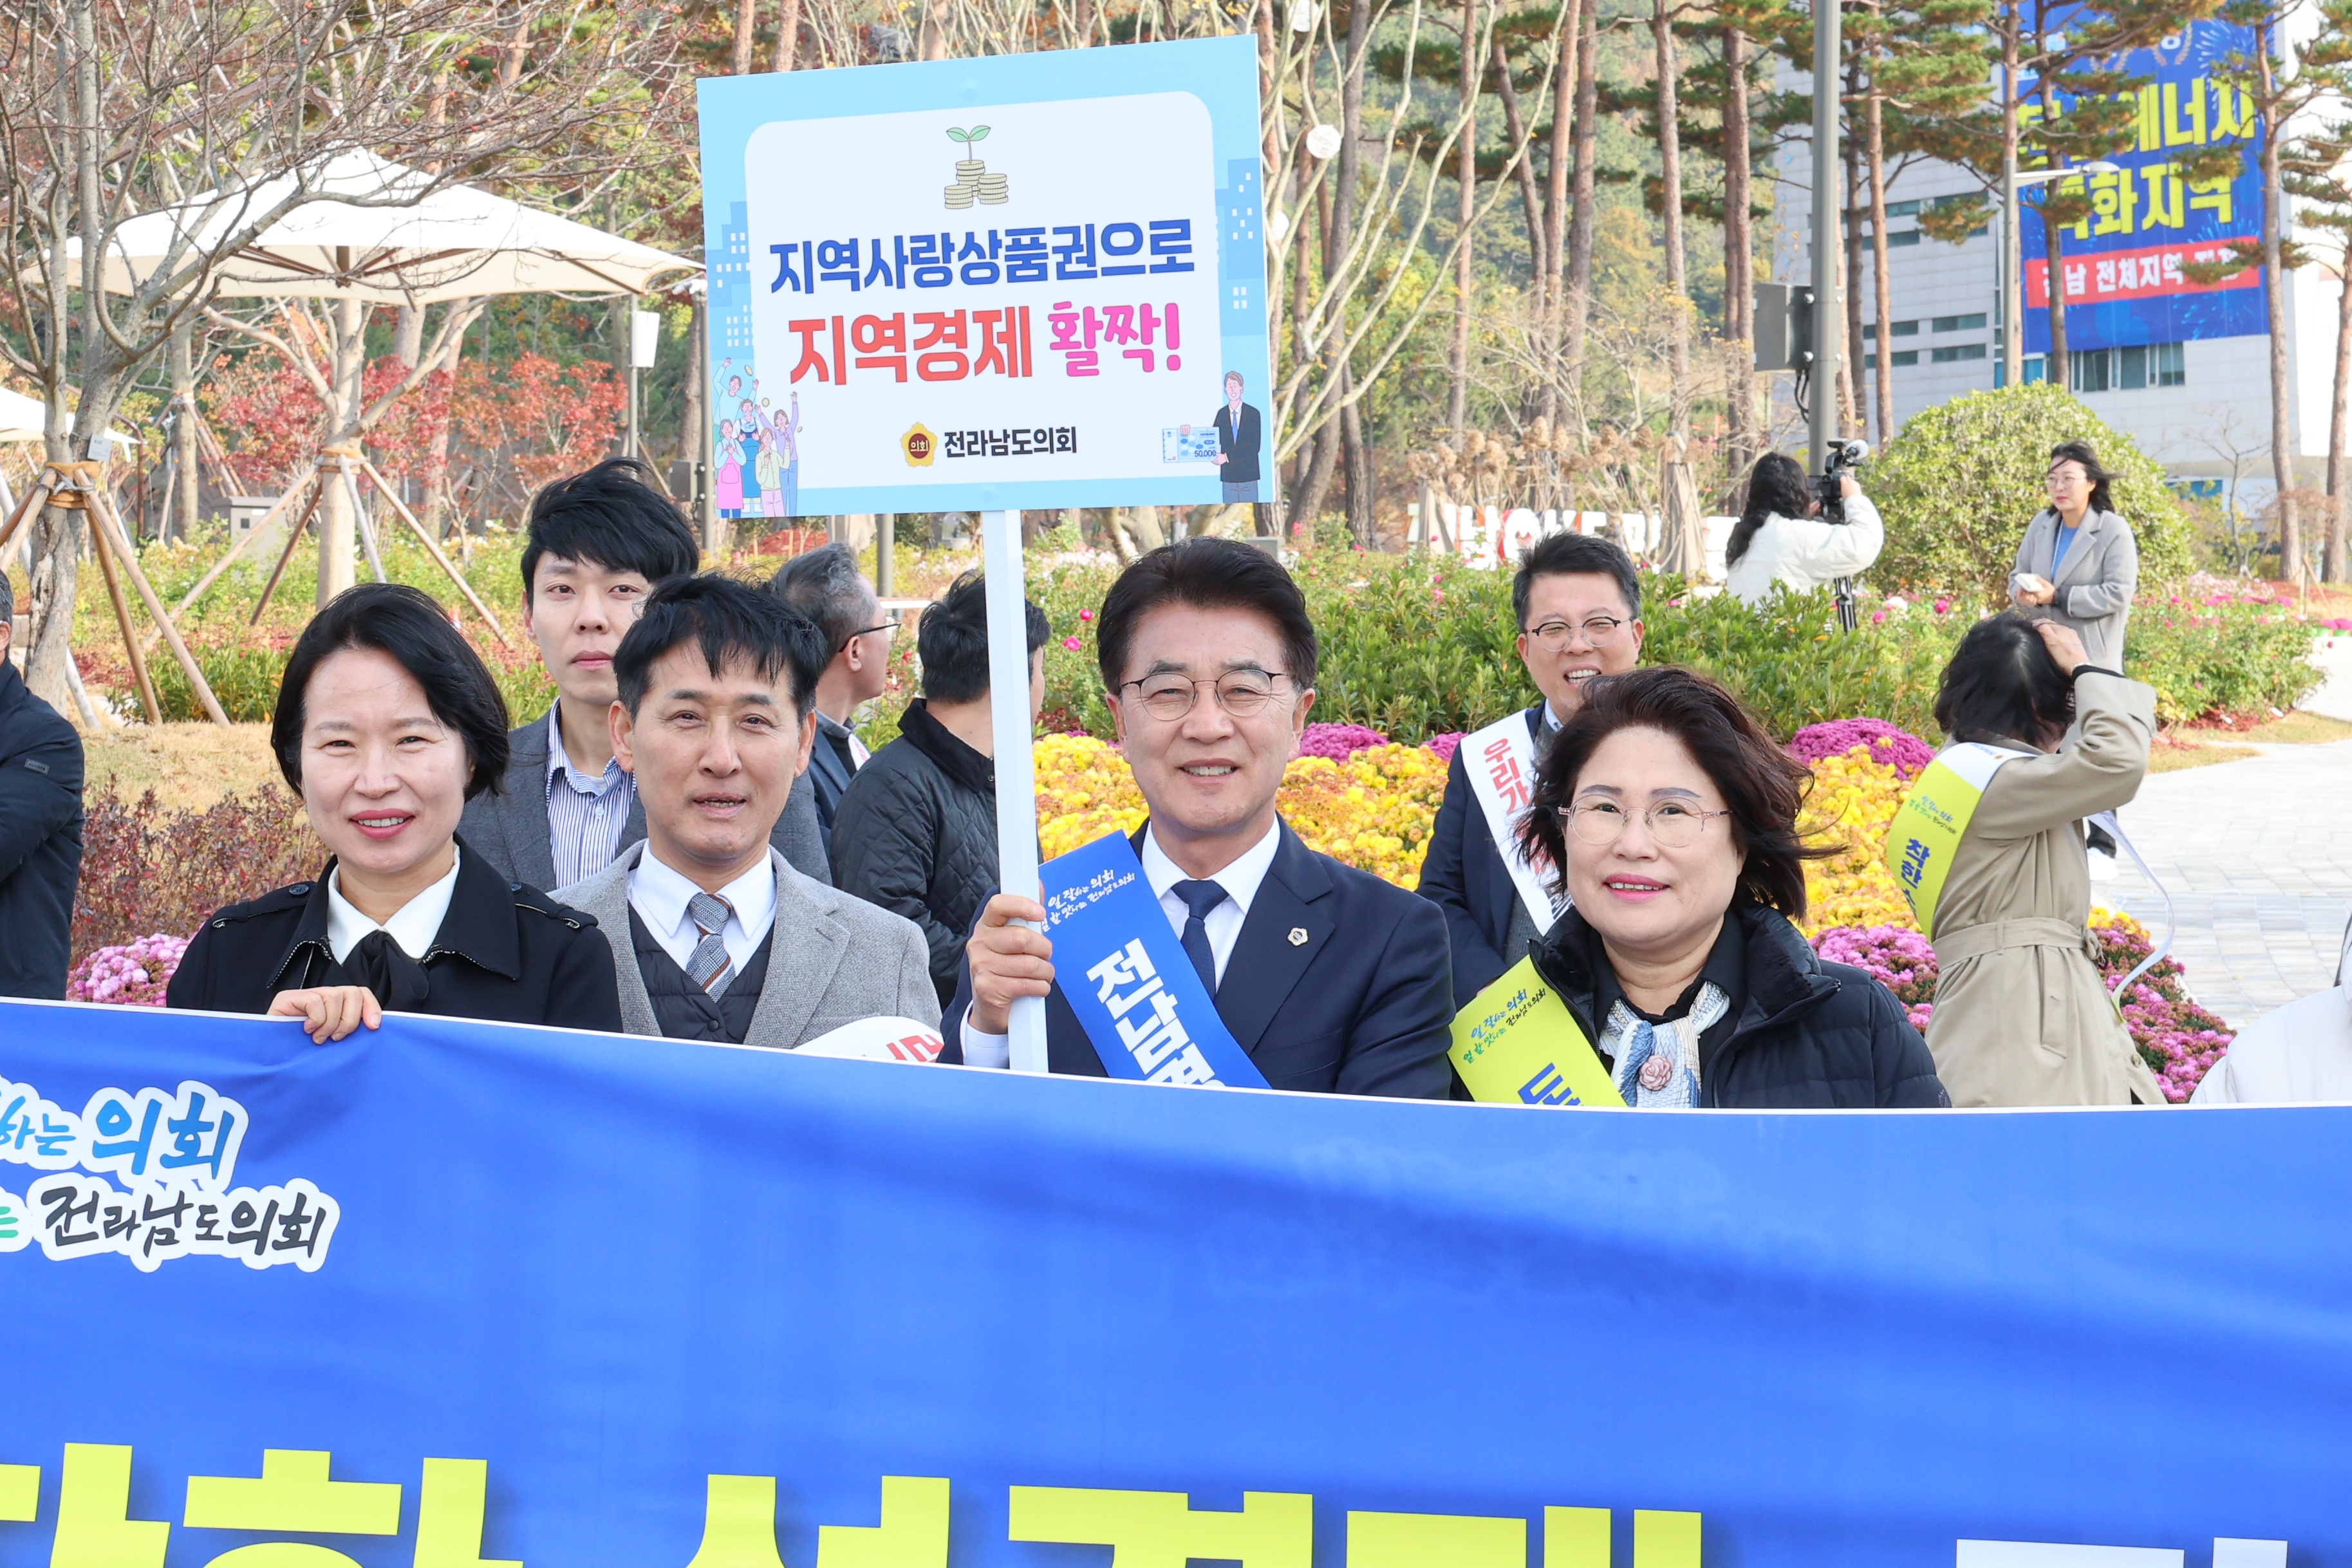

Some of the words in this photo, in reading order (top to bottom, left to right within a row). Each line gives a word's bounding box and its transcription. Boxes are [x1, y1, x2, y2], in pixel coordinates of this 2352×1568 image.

[770, 219, 1195, 294] 지역사랑상품권으로
[2096, 252, 2184, 293] 전체지역
[789, 305, 1032, 385] 지역경제
[1049, 301, 1181, 377] 활짝!
[910, 440, 929, 453] 의회
[944, 426, 1077, 458] 전라남도의회
[1048, 894, 1067, 910] 일
[1090, 869, 1115, 889] 의회
[1087, 872, 1135, 902] 전라남도의회
[1471, 1024, 1487, 1039] 일
[1507, 989, 1527, 1012] 의회
[1463, 1050, 1475, 1064] 일
[0, 1093, 77, 1156] 하는
[92, 1092, 235, 1179] 의회
[41, 1186, 326, 1258] 전라남도의회
